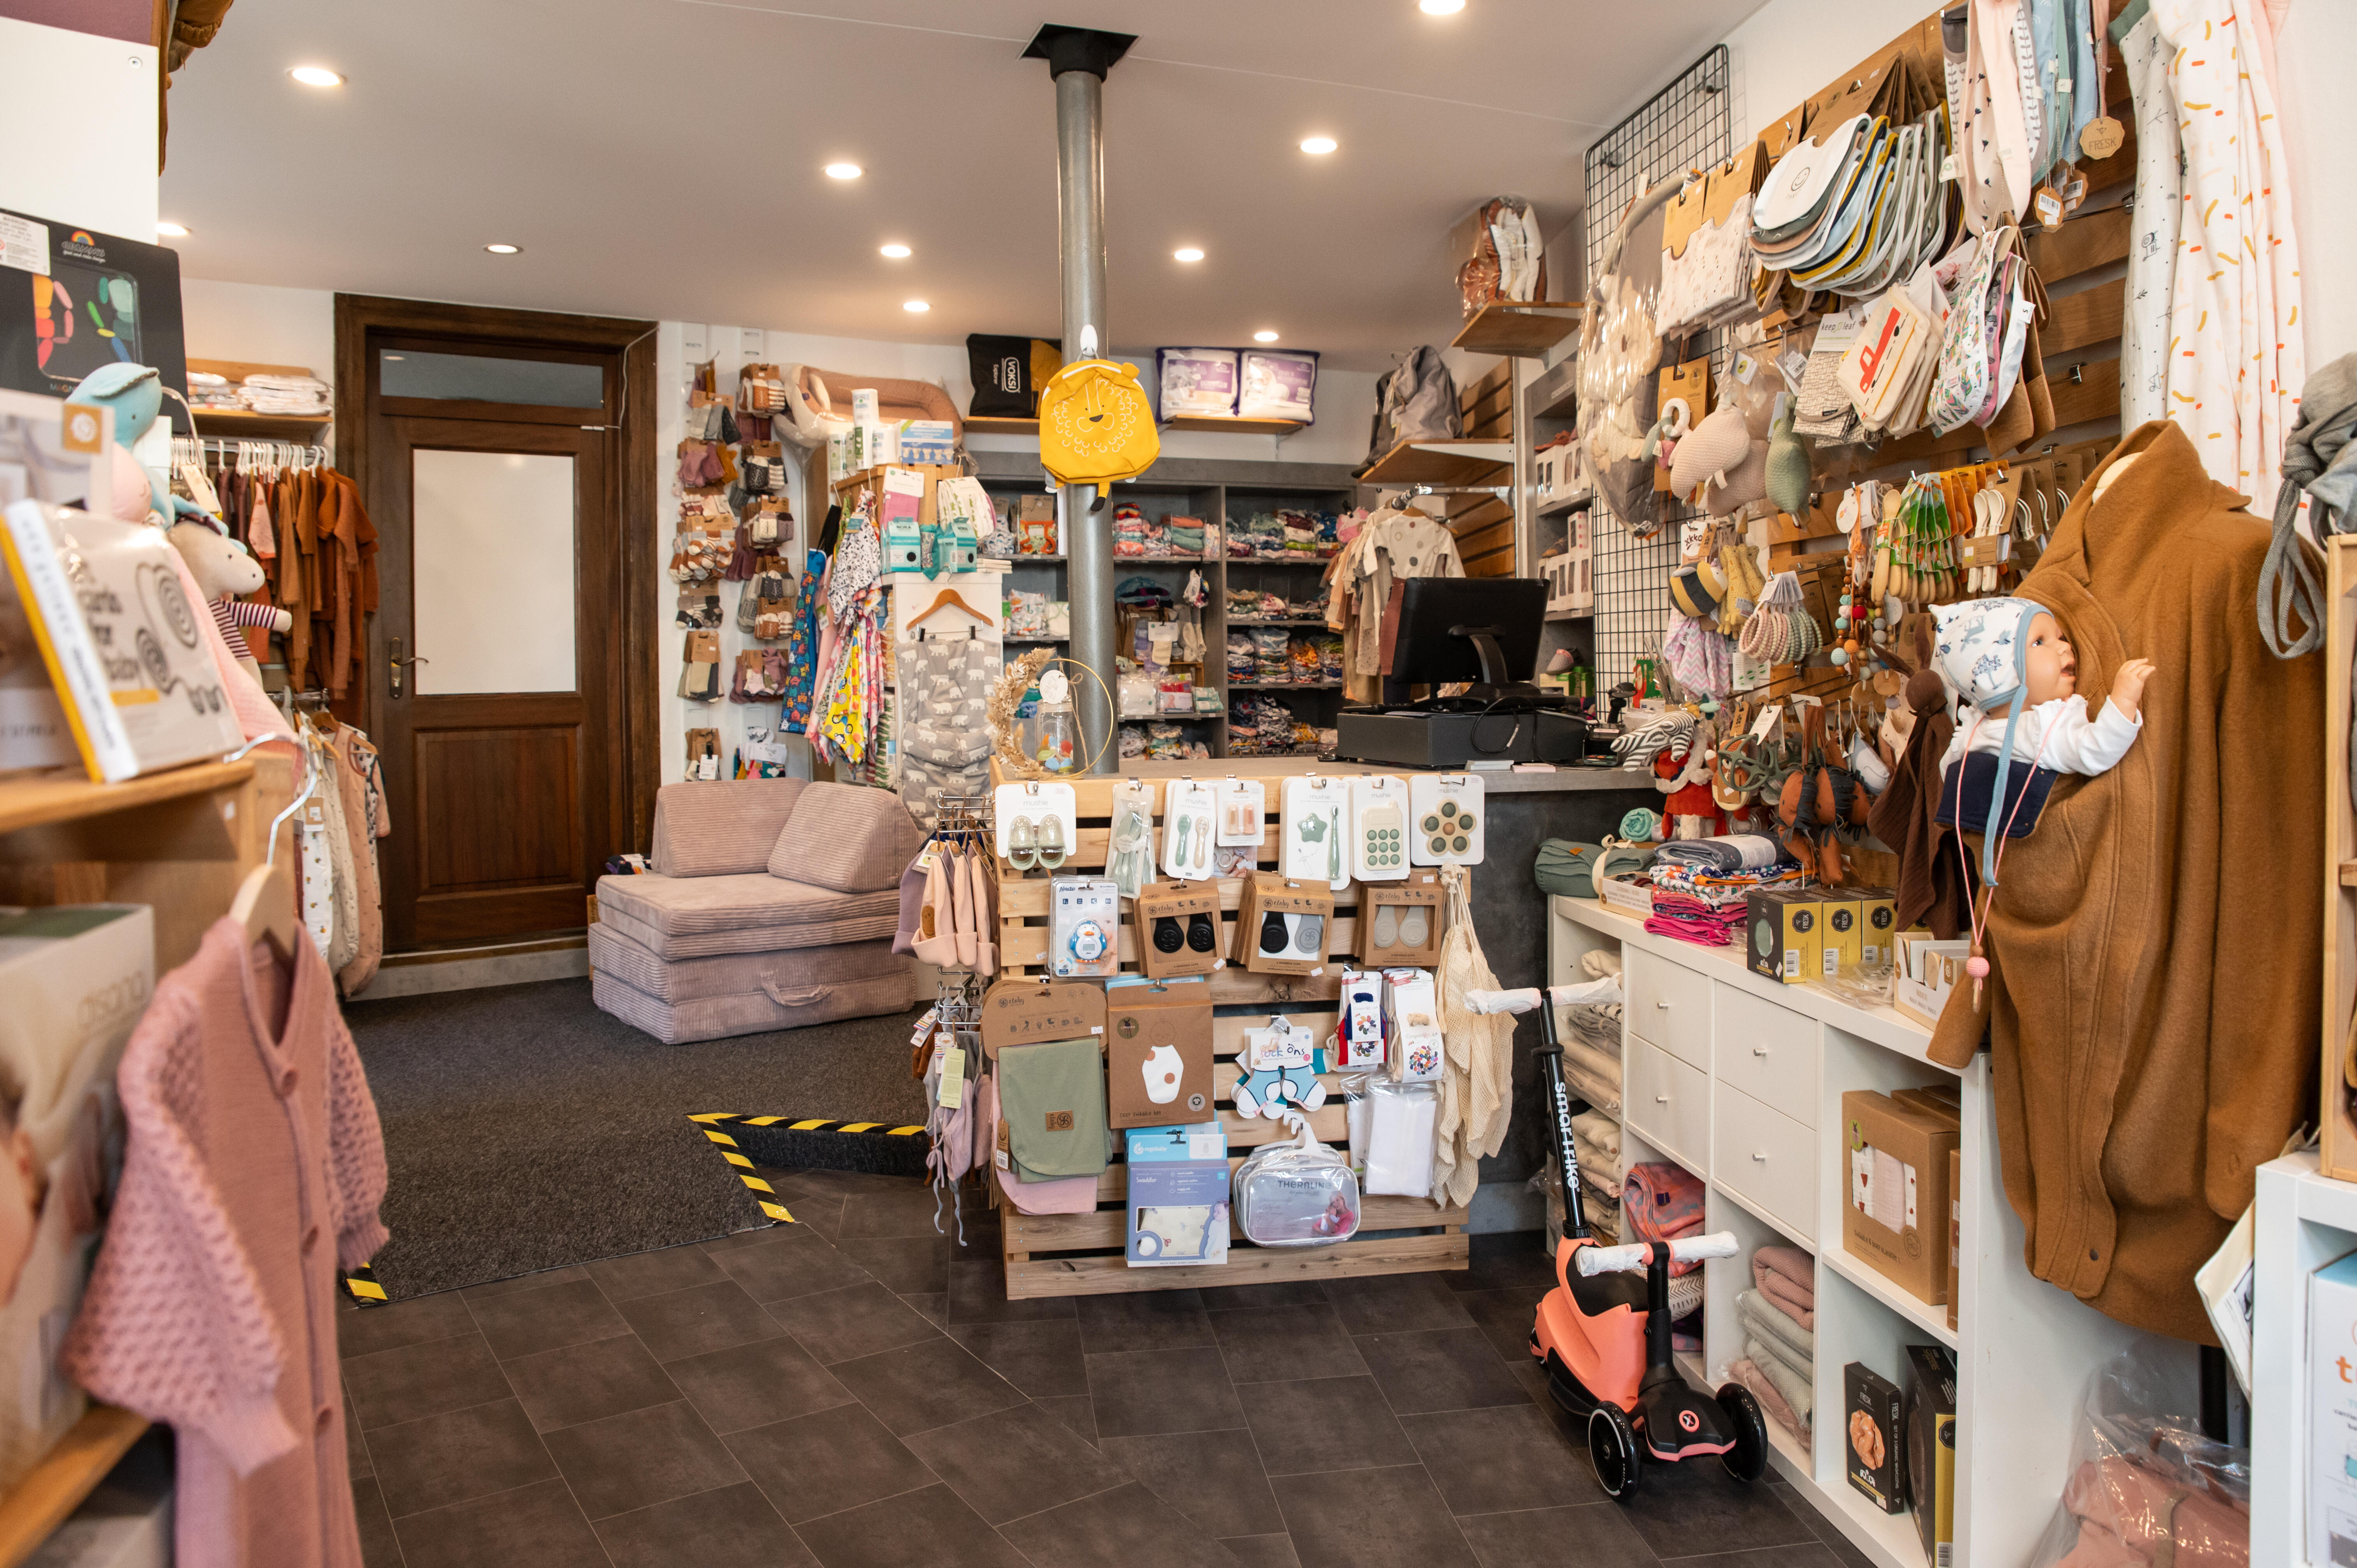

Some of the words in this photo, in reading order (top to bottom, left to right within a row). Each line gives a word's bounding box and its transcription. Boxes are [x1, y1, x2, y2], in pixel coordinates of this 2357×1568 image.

[2089, 140, 2117, 151] FRESK
[1821, 322, 1836, 332] keep
[1843, 321, 1855, 330] leaf
[1007, 361, 1016, 389] VOKSI
[1260, 1045, 1283, 1058] sock
[1860, 1391, 1871, 1406] FRESK
